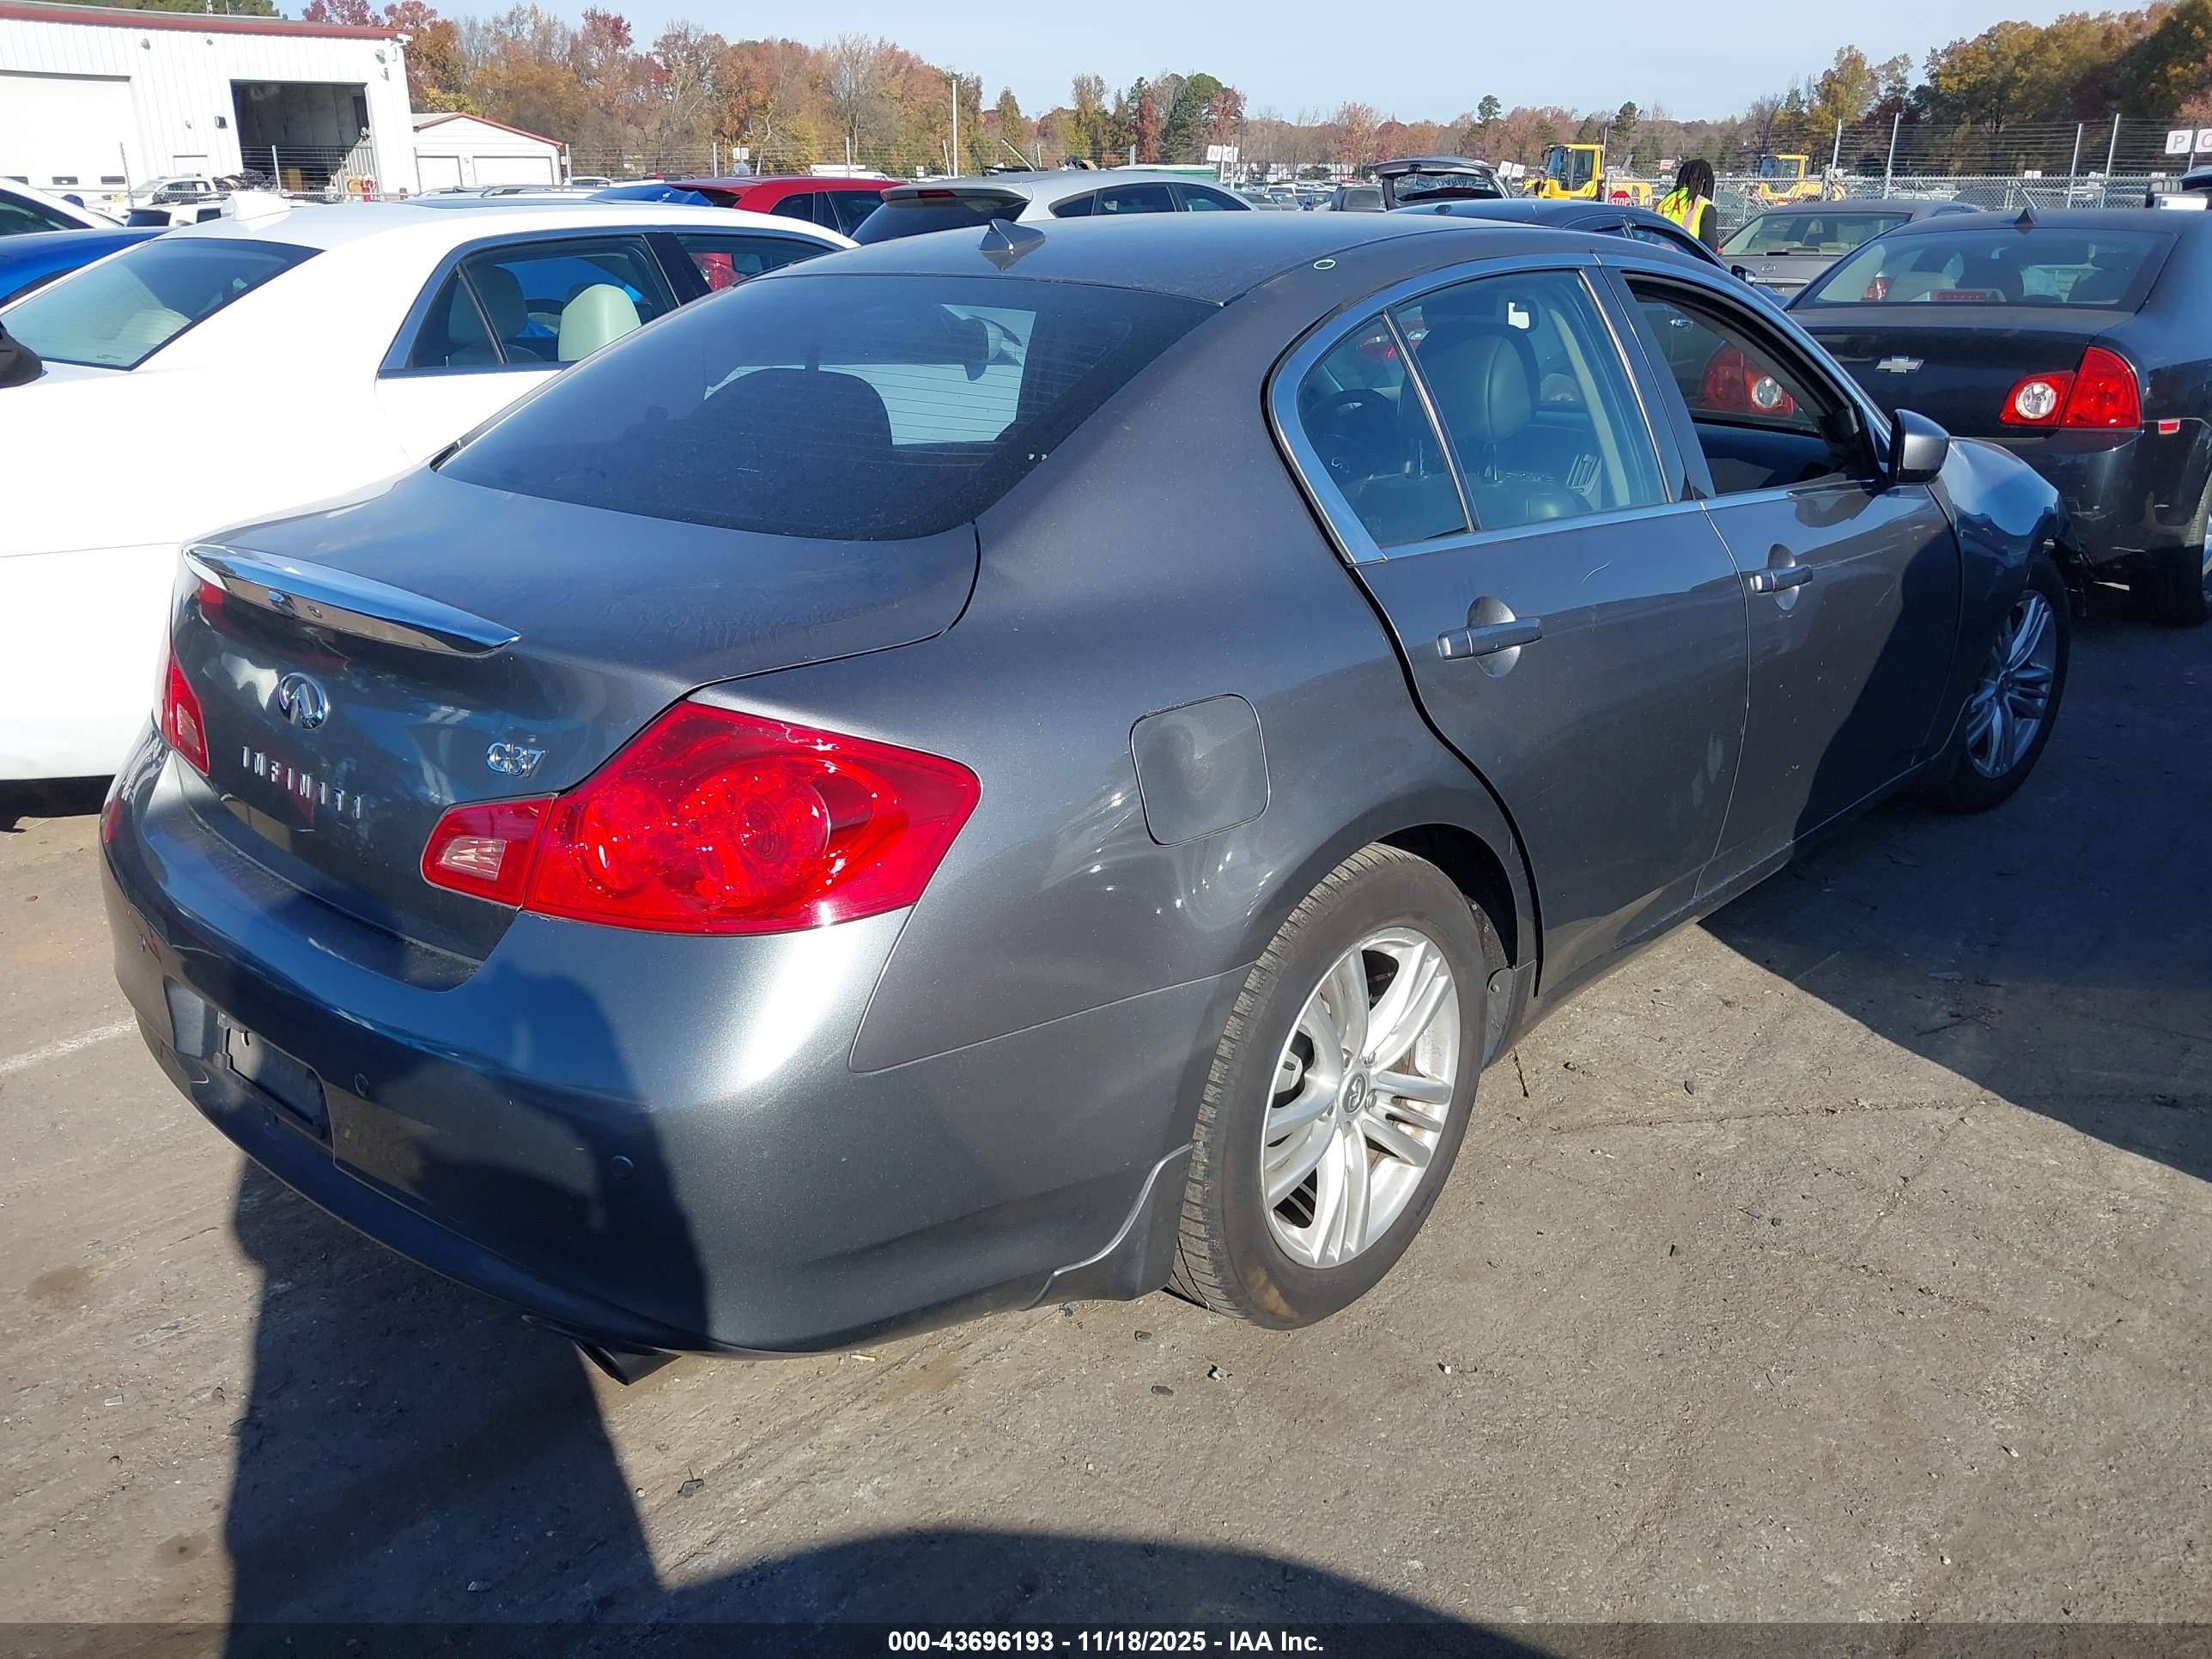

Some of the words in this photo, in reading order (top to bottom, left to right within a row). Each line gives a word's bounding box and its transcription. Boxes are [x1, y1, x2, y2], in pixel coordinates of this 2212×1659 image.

[2172, 135, 2186, 149] P
[1210, 149, 1219, 158] N
[1611, 197, 1631, 207] STOP
[486, 742, 546, 777] G37
[242, 745, 364, 819] INFINITI
